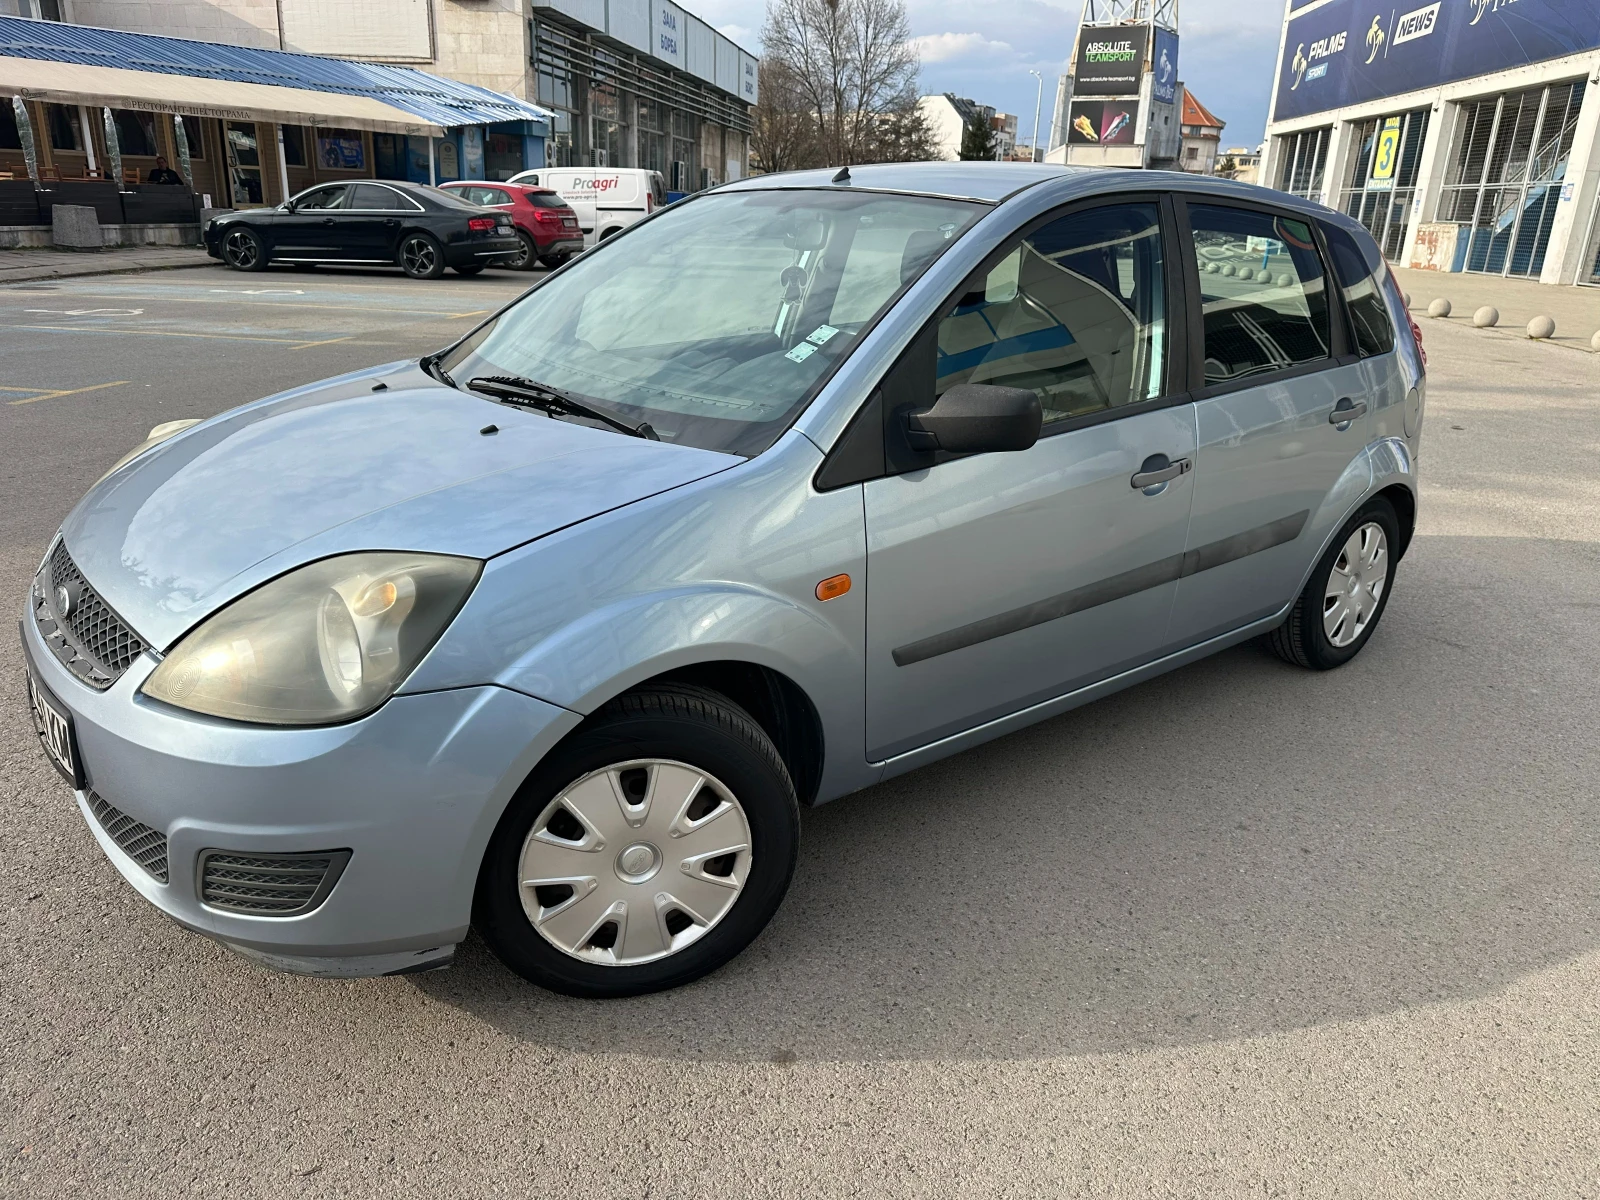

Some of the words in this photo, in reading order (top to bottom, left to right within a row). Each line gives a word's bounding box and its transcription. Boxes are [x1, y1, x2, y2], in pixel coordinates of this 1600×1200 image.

[662, 9, 677, 31] ЗАЛА
[1398, 9, 1434, 38] NEWS
[660, 33, 677, 56] БОРБА
[1086, 40, 1131, 52] ABSOLUTE
[1308, 31, 1347, 62] PALMS
[1085, 52, 1136, 63] TEAMSPORT
[1308, 65, 1326, 79] SPORT
[1379, 136, 1393, 171] 3
[572, 175, 619, 192] Proagri
